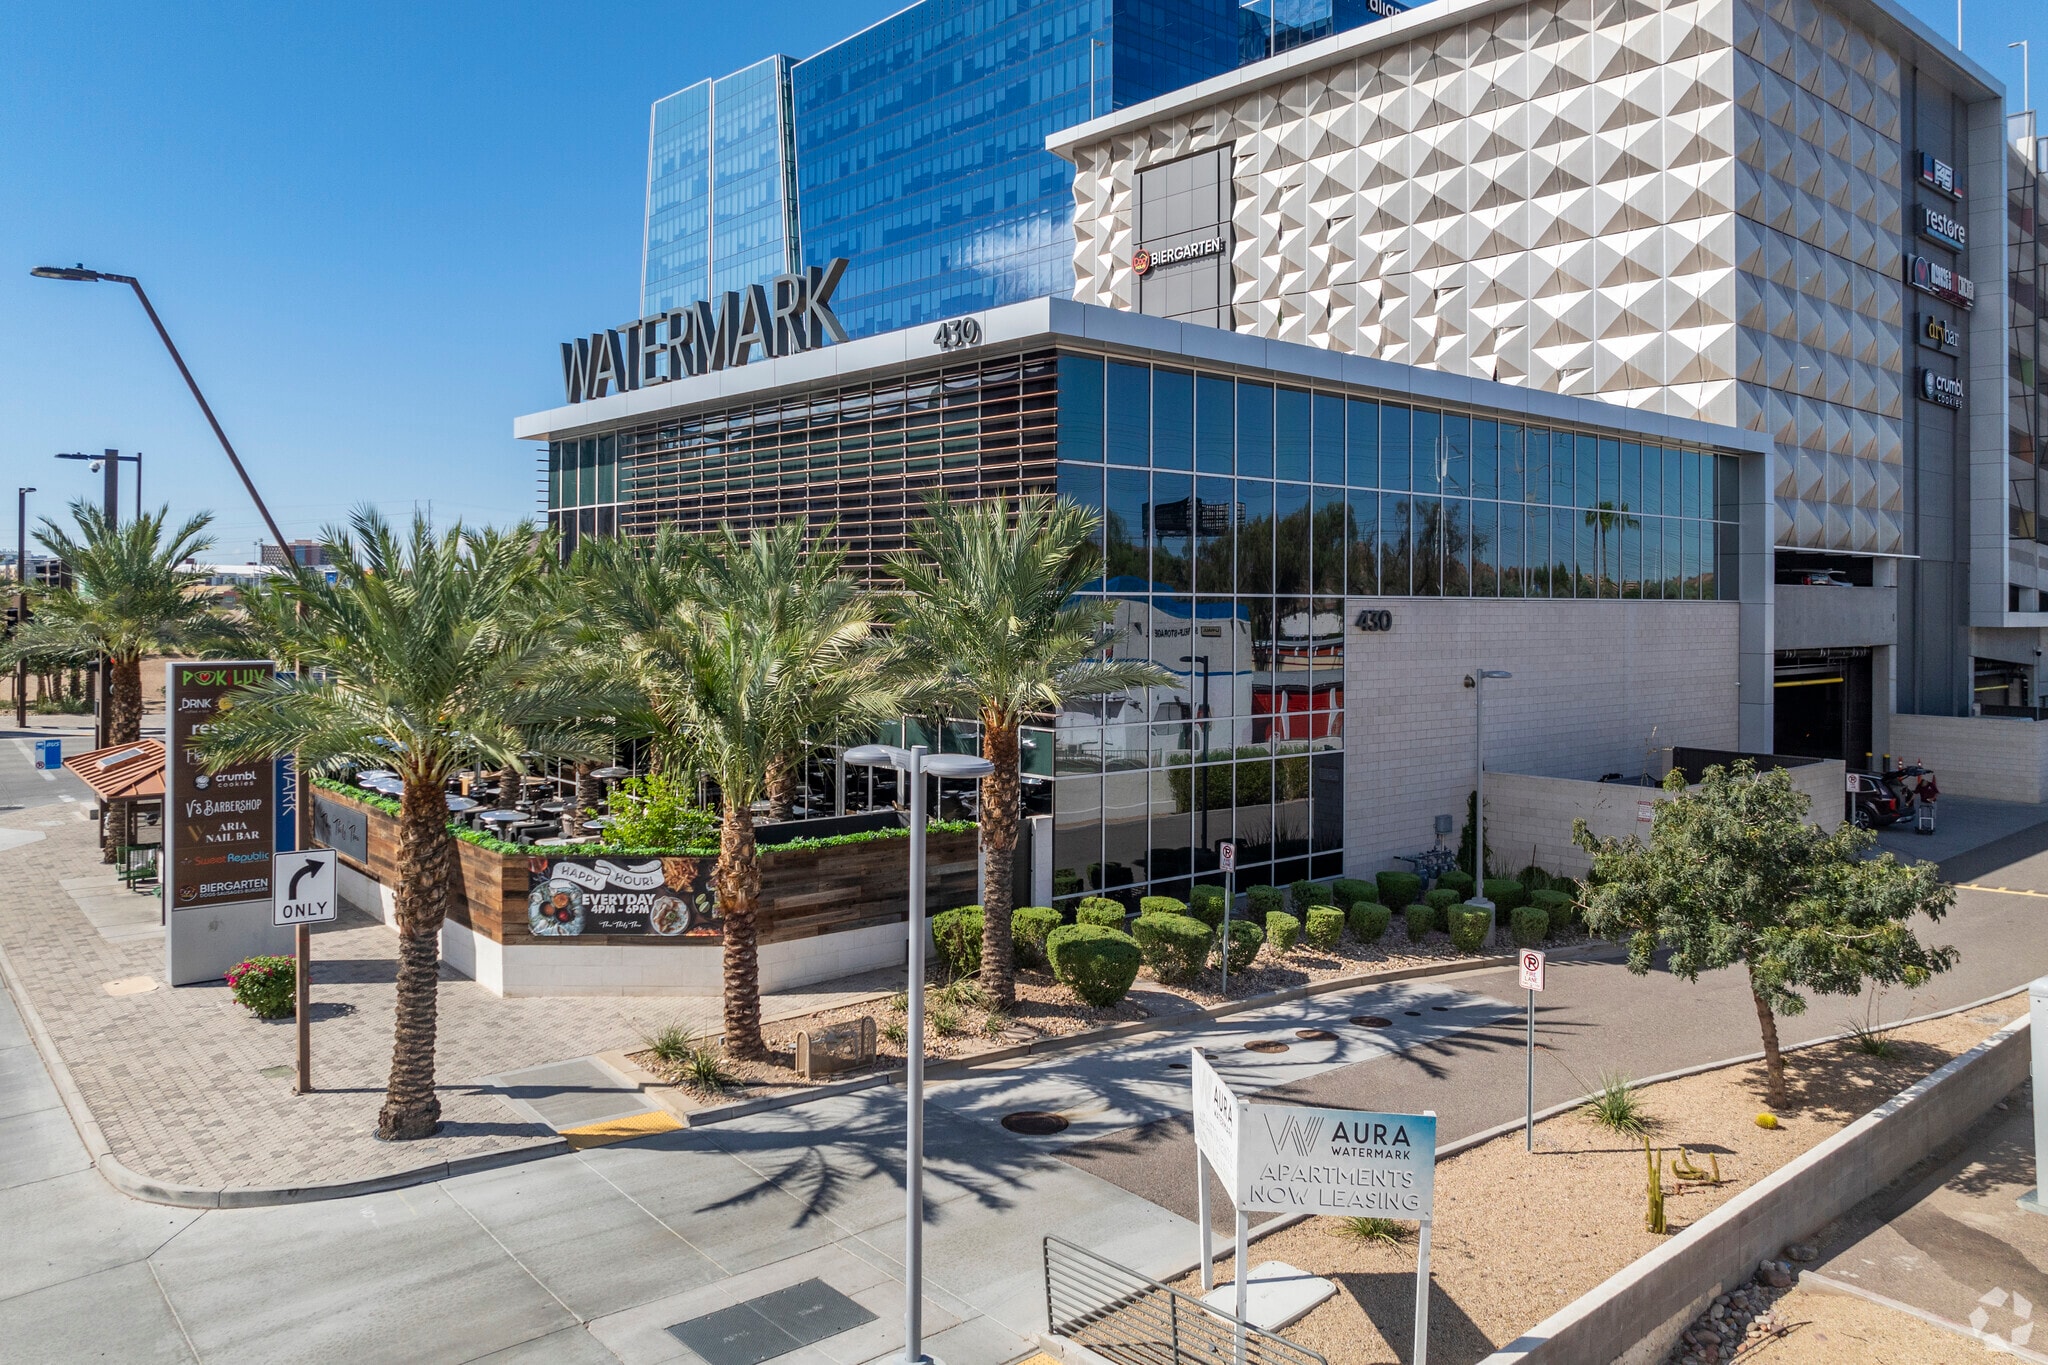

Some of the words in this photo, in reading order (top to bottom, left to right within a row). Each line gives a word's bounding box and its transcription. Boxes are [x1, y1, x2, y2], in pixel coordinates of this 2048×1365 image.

[1926, 208, 1965, 244] restore
[1150, 237, 1222, 266] BIERGARTEN
[560, 257, 850, 404] WATERMARK
[932, 316, 981, 348] 430
[1936, 375, 1964, 398] crumbl
[1937, 393, 1963, 409] cookies
[1355, 609, 1393, 631] 430
[216, 770, 257, 783] crumbl
[217, 780, 254, 788] cookies
[205, 833, 234, 843] NAIL
[236, 830, 260, 841] BAR
[218, 821, 248, 832] ARIA
[227, 850, 270, 864] Republic
[561, 865, 601, 885] HAPPY
[614, 872, 654, 886] HOUR!
[200, 878, 269, 894] BIERGARTEN
[581, 893, 656, 906] EVERYDAY
[590, 905, 615, 914] 4PM
[625, 905, 650, 914] 6PM
[282, 900, 328, 920] ONLY
[1213, 1085, 1233, 1128] AURA
[1331, 1121, 1411, 1147] AURA
[1331, 1146, 1411, 1160] WATERMARK
[1259, 1163, 1415, 1189] APARTMENTS
[1250, 1184, 1309, 1205] NOW
[1318, 1188, 1421, 1211] LEASING
